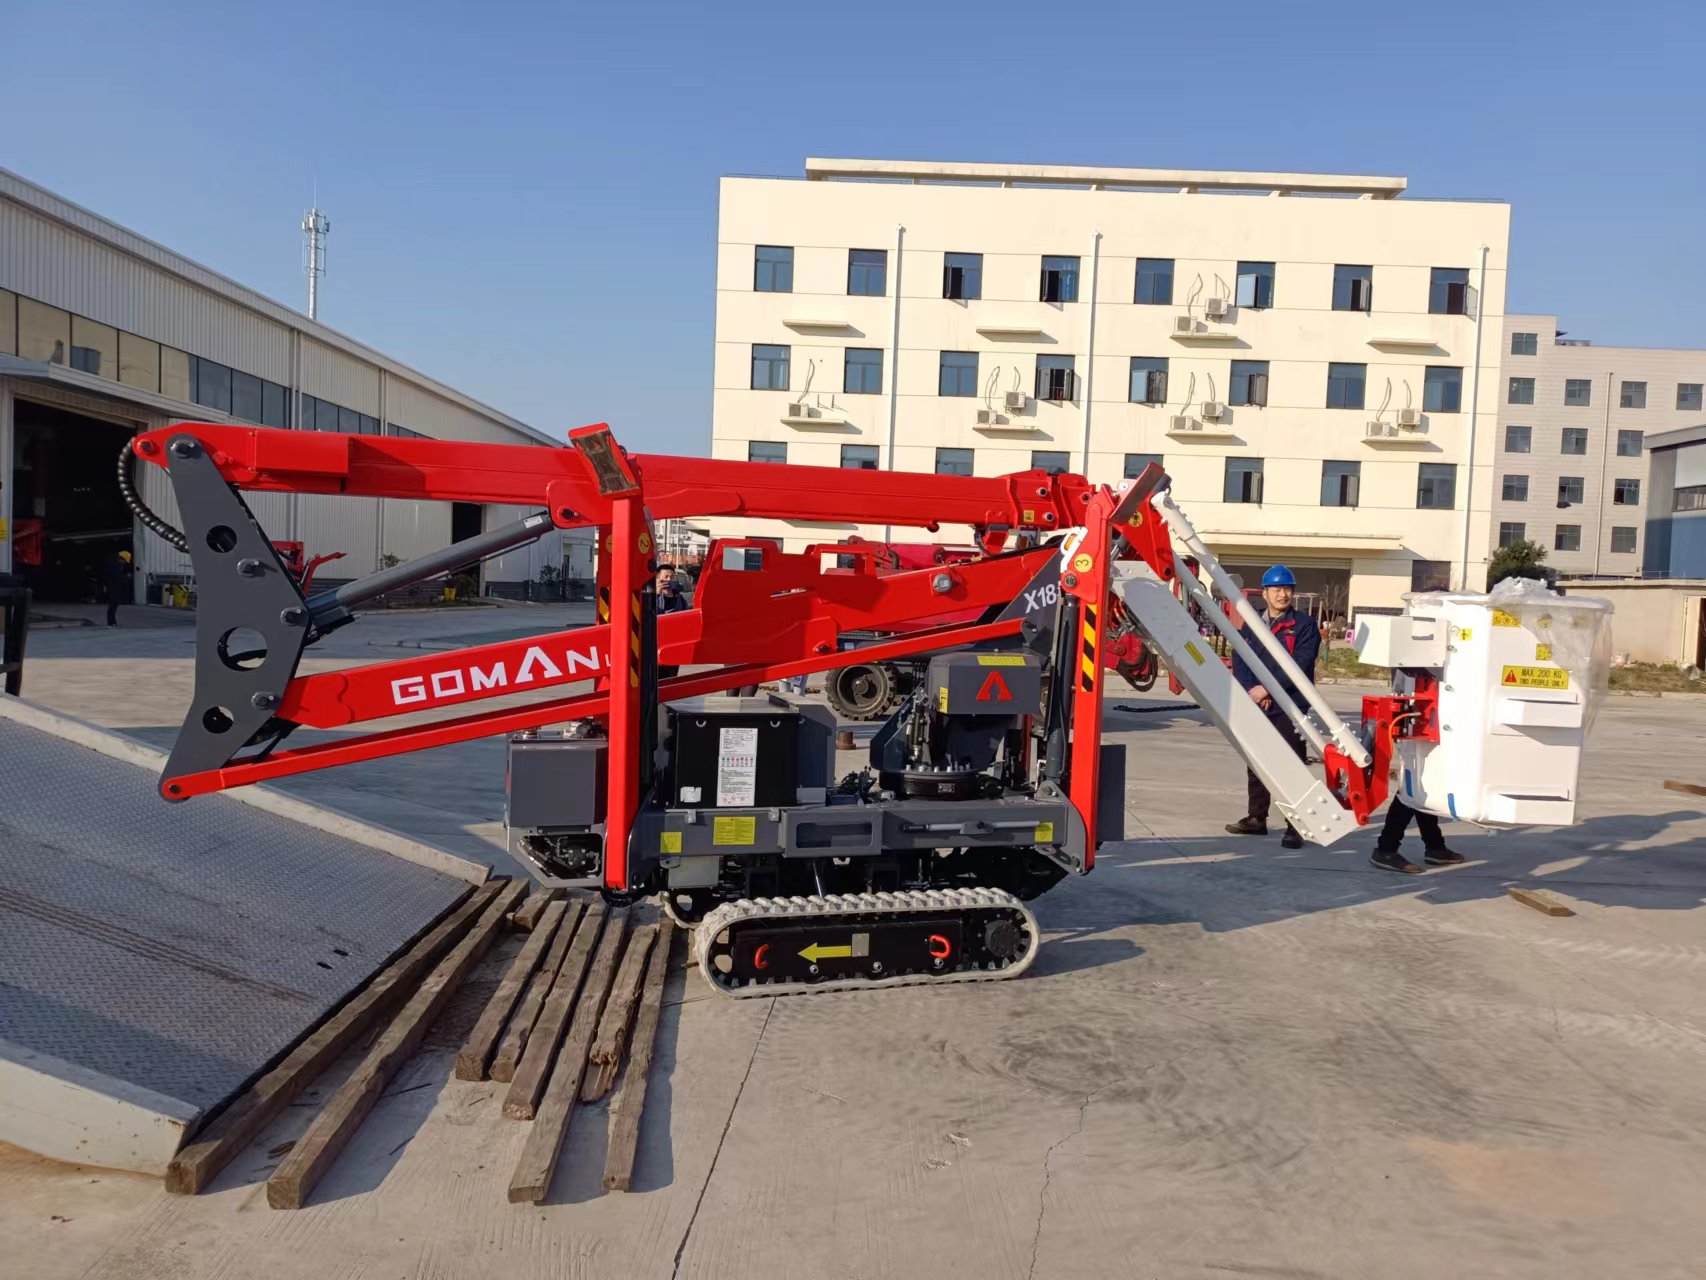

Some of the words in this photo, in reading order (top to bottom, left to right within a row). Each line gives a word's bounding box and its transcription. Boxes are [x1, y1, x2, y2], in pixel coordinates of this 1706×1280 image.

[1075, 559, 1089, 567] 3
[391, 646, 600, 705] GOMAN
[1521, 668, 1534, 677] MAX
[1538, 669, 1550, 678] 200
[1553, 670, 1562, 679] KG
[1531, 678, 1549, 687] PEOPLE
